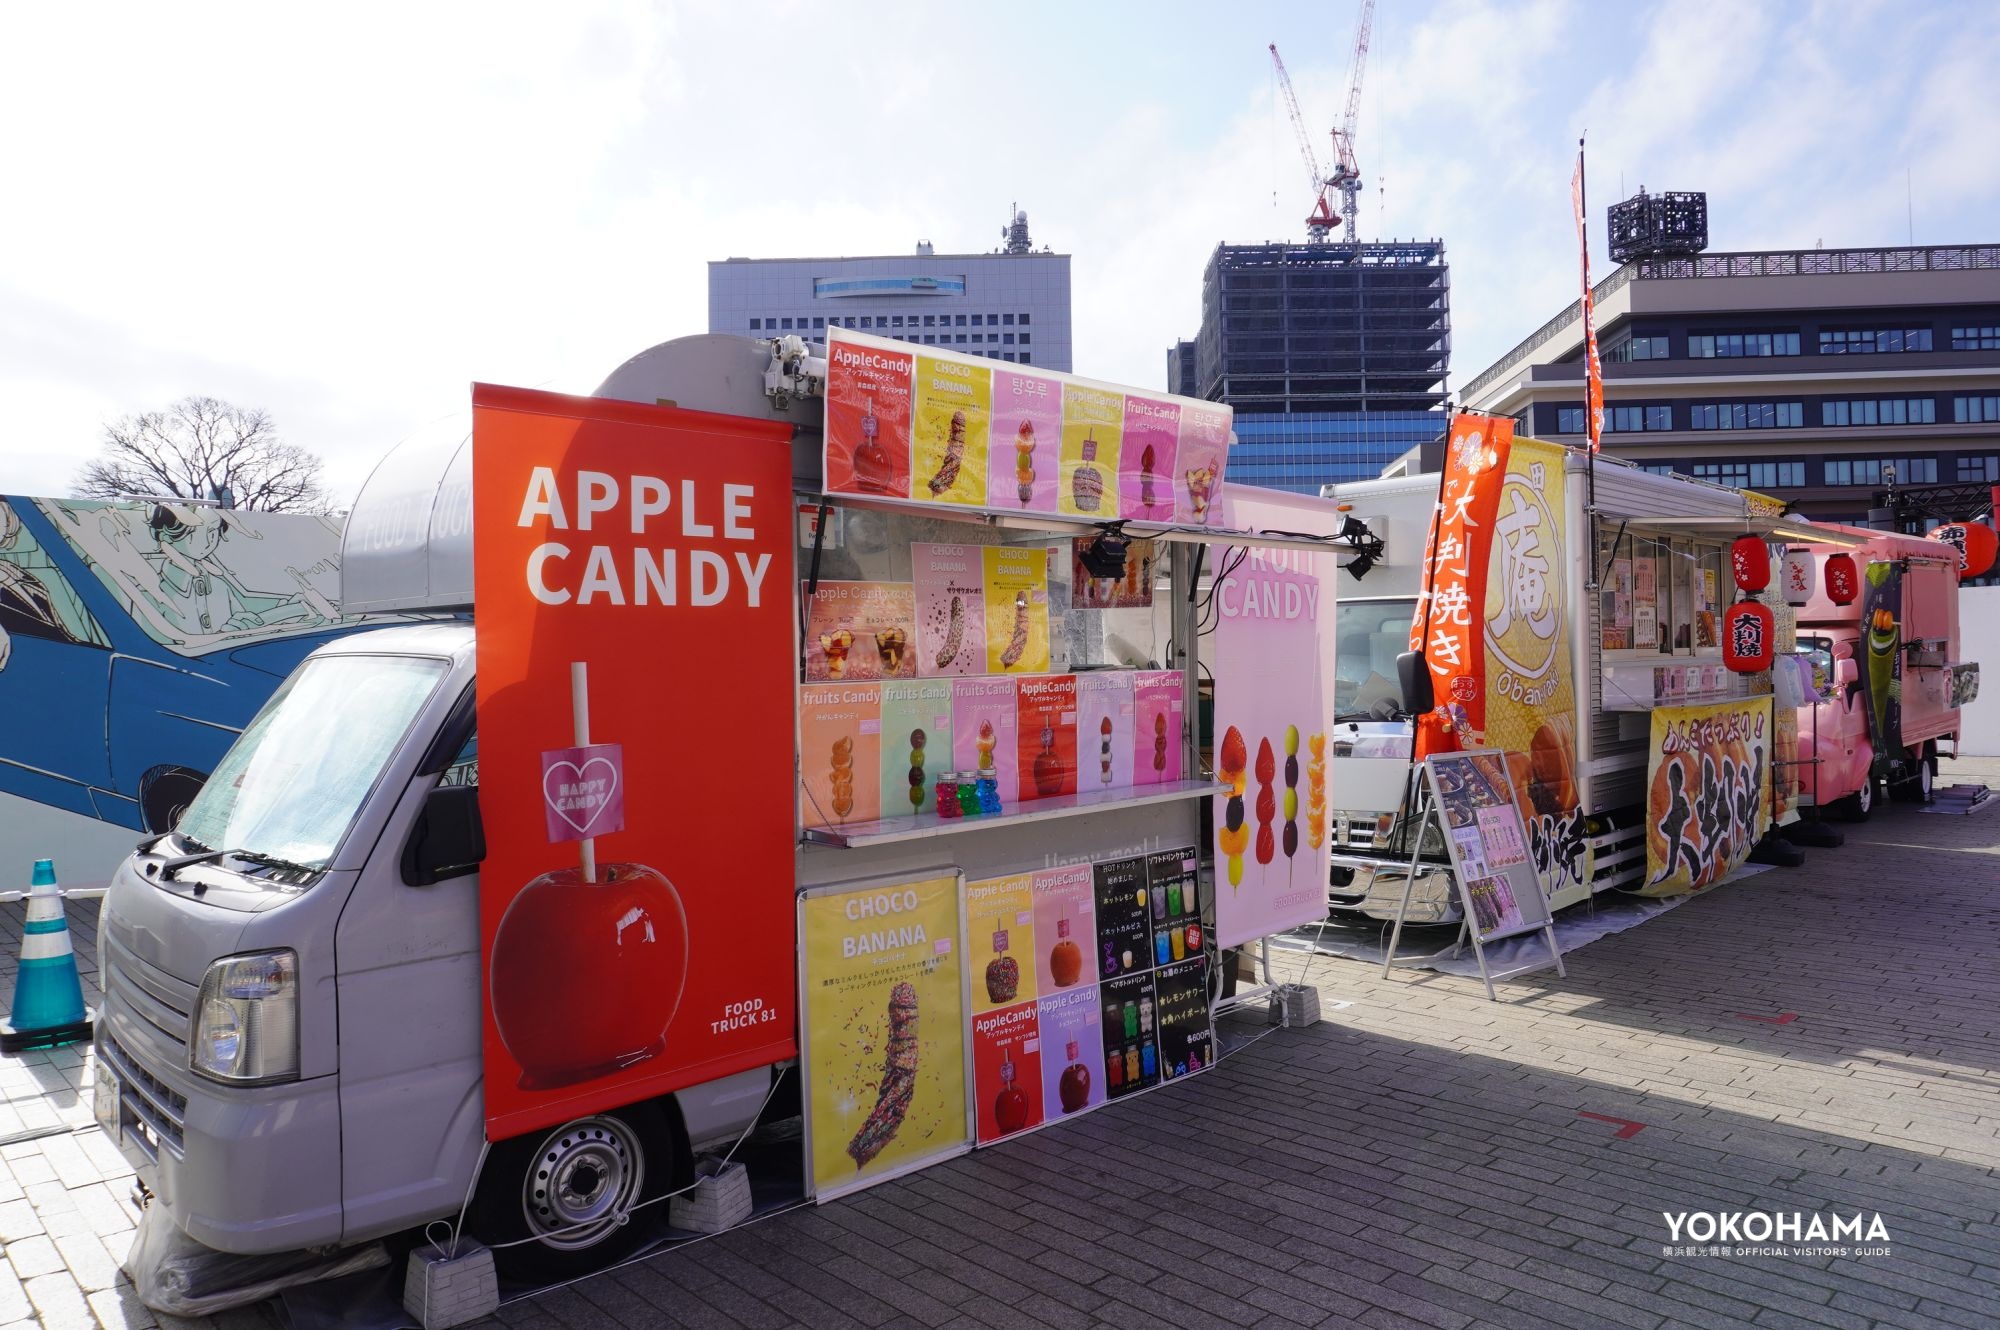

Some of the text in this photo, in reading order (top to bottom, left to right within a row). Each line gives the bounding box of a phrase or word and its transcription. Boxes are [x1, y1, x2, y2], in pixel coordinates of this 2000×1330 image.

[834, 348, 912, 376] AppleCandy
[934, 361, 971, 378] CHOCO
[933, 379, 973, 396] BANANA
[1012, 377, 1047, 398] 탕후루
[1127, 400, 1153, 416] fruits
[1154, 406, 1181, 423] Candy
[517, 466, 754, 540] APPLE
[931, 546, 964, 557] CHOCO
[999, 550, 1029, 560] CHOCO
[527, 542, 772, 608] CANDY
[931, 561, 967, 572] BANANA
[997, 564, 1032, 576] BANANA
[1429, 481, 1480, 676] 大判焼き
[1218, 577, 1319, 620] CANDY
[1733, 613, 1762, 658] 大判焼
[956, 683, 1016, 697] fruits Candy
[1020, 680, 1076, 696] AppleCandy
[1107, 678, 1133, 691] Candy
[1137, 676, 1183, 688] fruits Candy
[803, 689, 880, 704] fruits Candy
[886, 686, 952, 701] fruits Candy
[559, 778, 606, 796] HAPPY
[557, 794, 605, 811] CANDY
[967, 877, 1031, 899] Apple Candy
[1035, 870, 1091, 890] AppleCandy
[846, 889, 918, 921] CHOCO
[843, 923, 926, 958] BANANA
[725, 999, 763, 1017] FOOD
[1040, 988, 1098, 1014] Apple Candy
[711, 1009, 776, 1034] TRUCK 81
[976, 1006, 1037, 1033] AppleCandy
